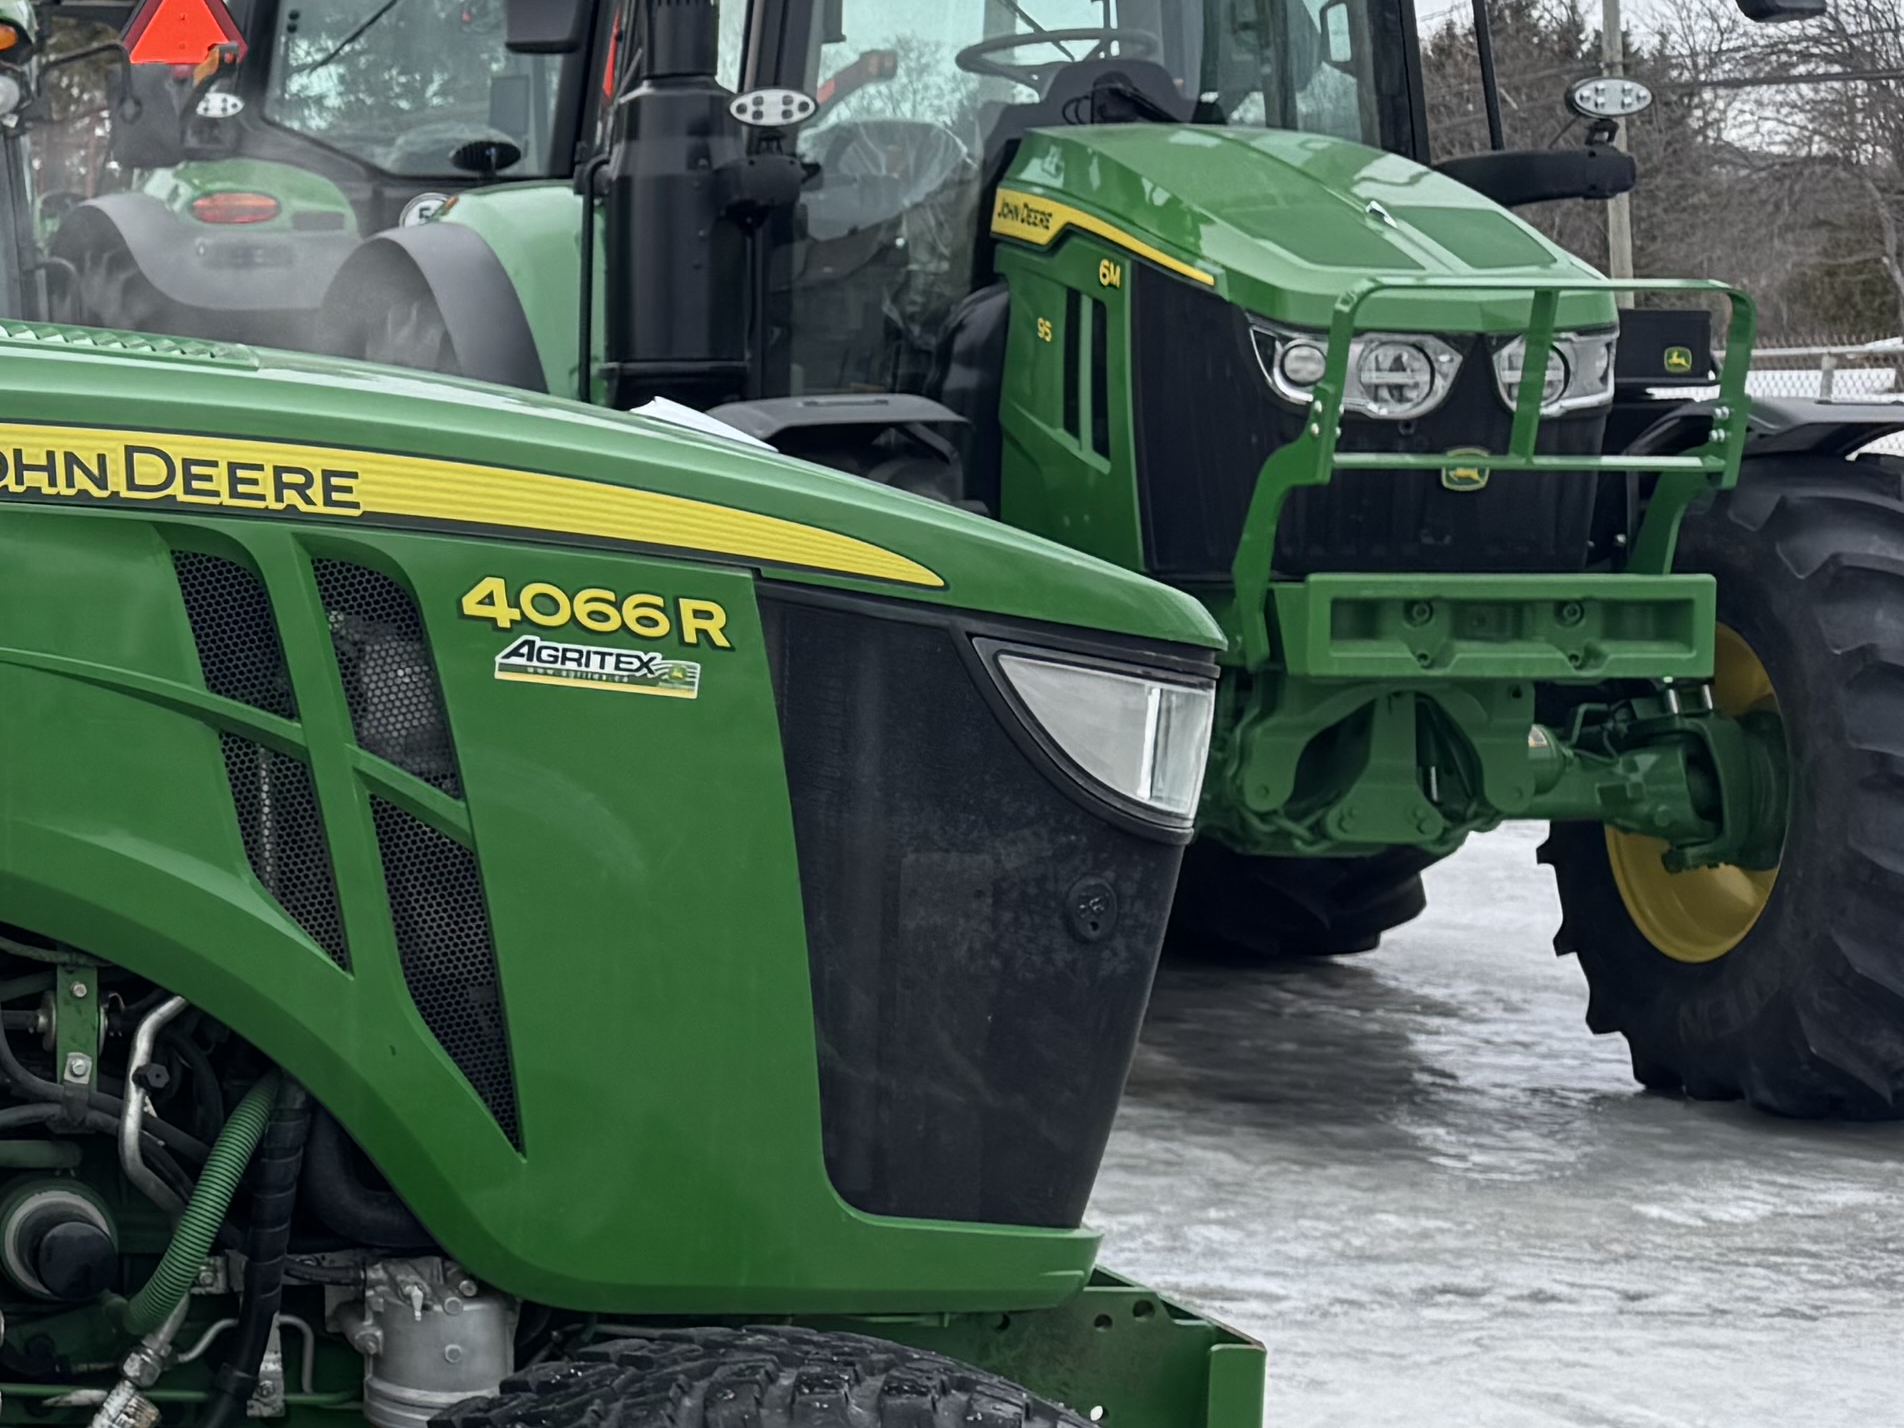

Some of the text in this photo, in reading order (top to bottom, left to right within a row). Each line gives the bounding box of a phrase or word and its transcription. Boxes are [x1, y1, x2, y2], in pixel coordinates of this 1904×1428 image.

[997, 197, 1053, 230] JOHN DEERE
[1098, 259, 1121, 289] 6M
[1037, 317, 1053, 342] 95
[124, 444, 361, 510] DEERE
[500, 638, 658, 676] AGRITEX
